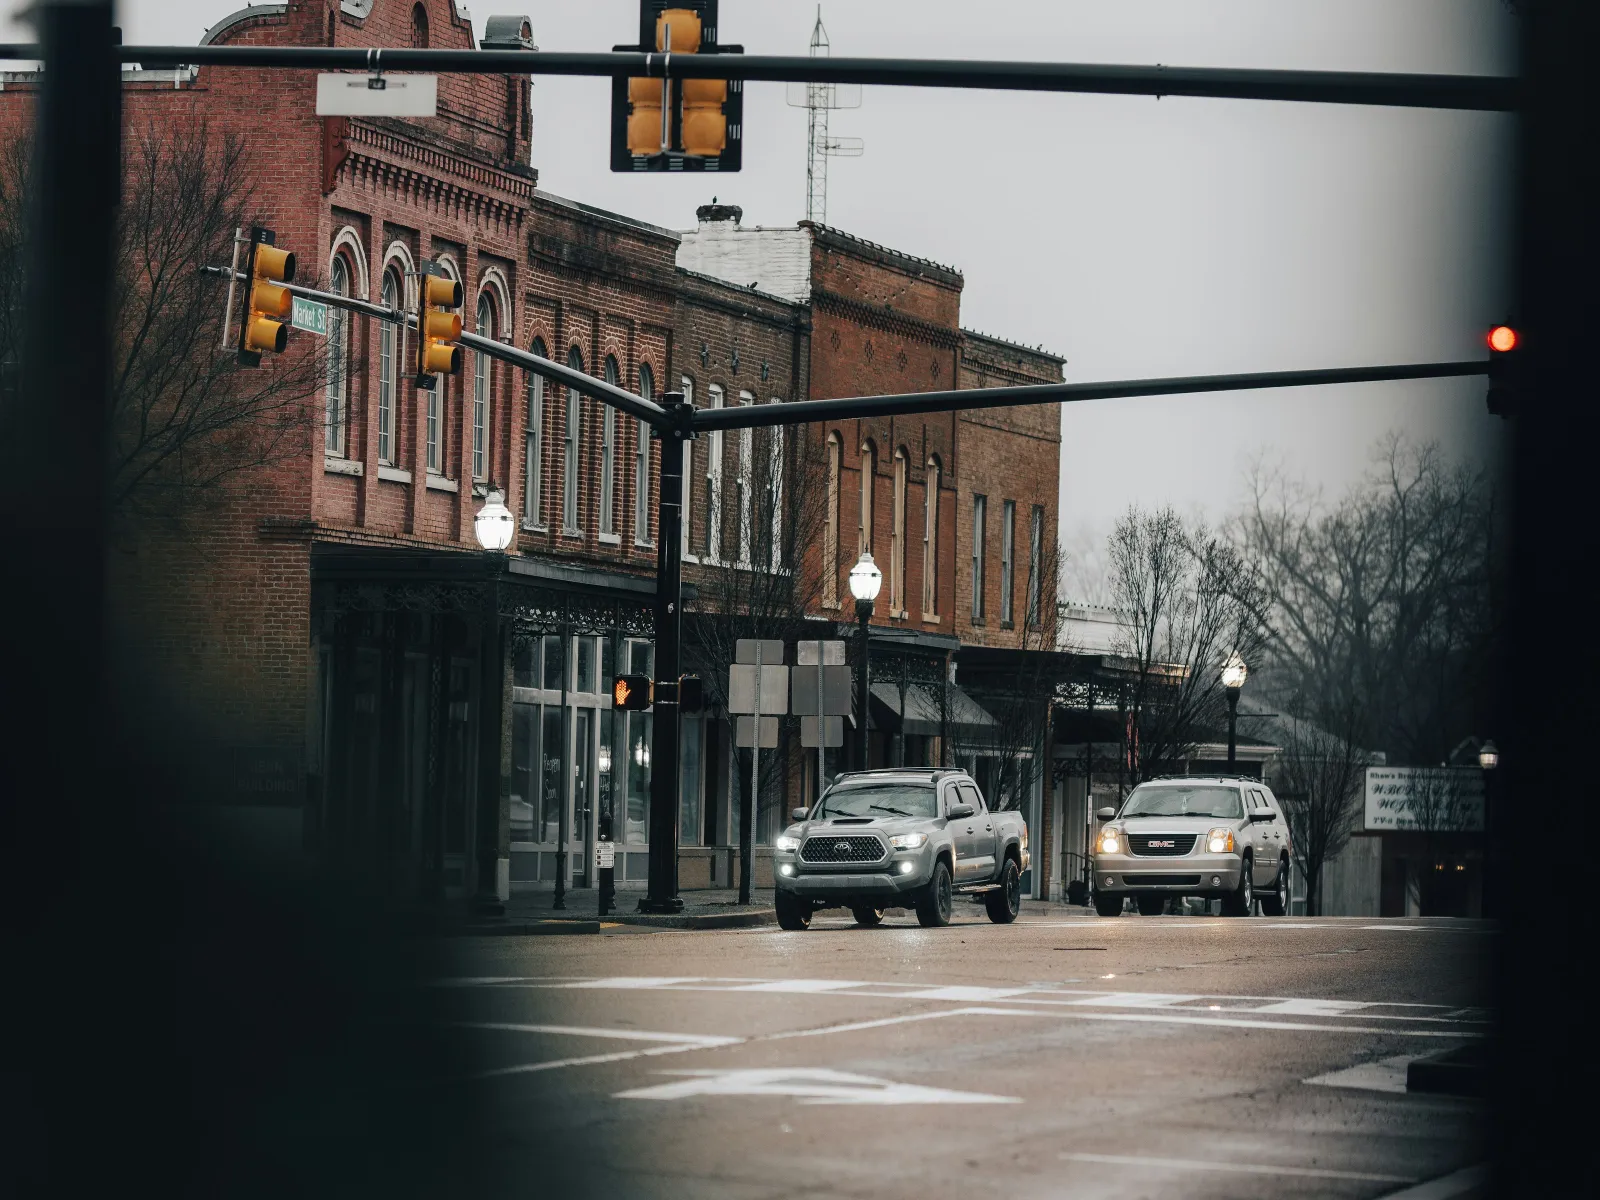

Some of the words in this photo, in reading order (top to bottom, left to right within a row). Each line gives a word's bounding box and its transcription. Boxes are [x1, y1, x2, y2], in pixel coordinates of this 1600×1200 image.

[293, 300, 315, 327] Market
[317, 308, 326, 330] St
[1148, 840, 1175, 848] GMC
